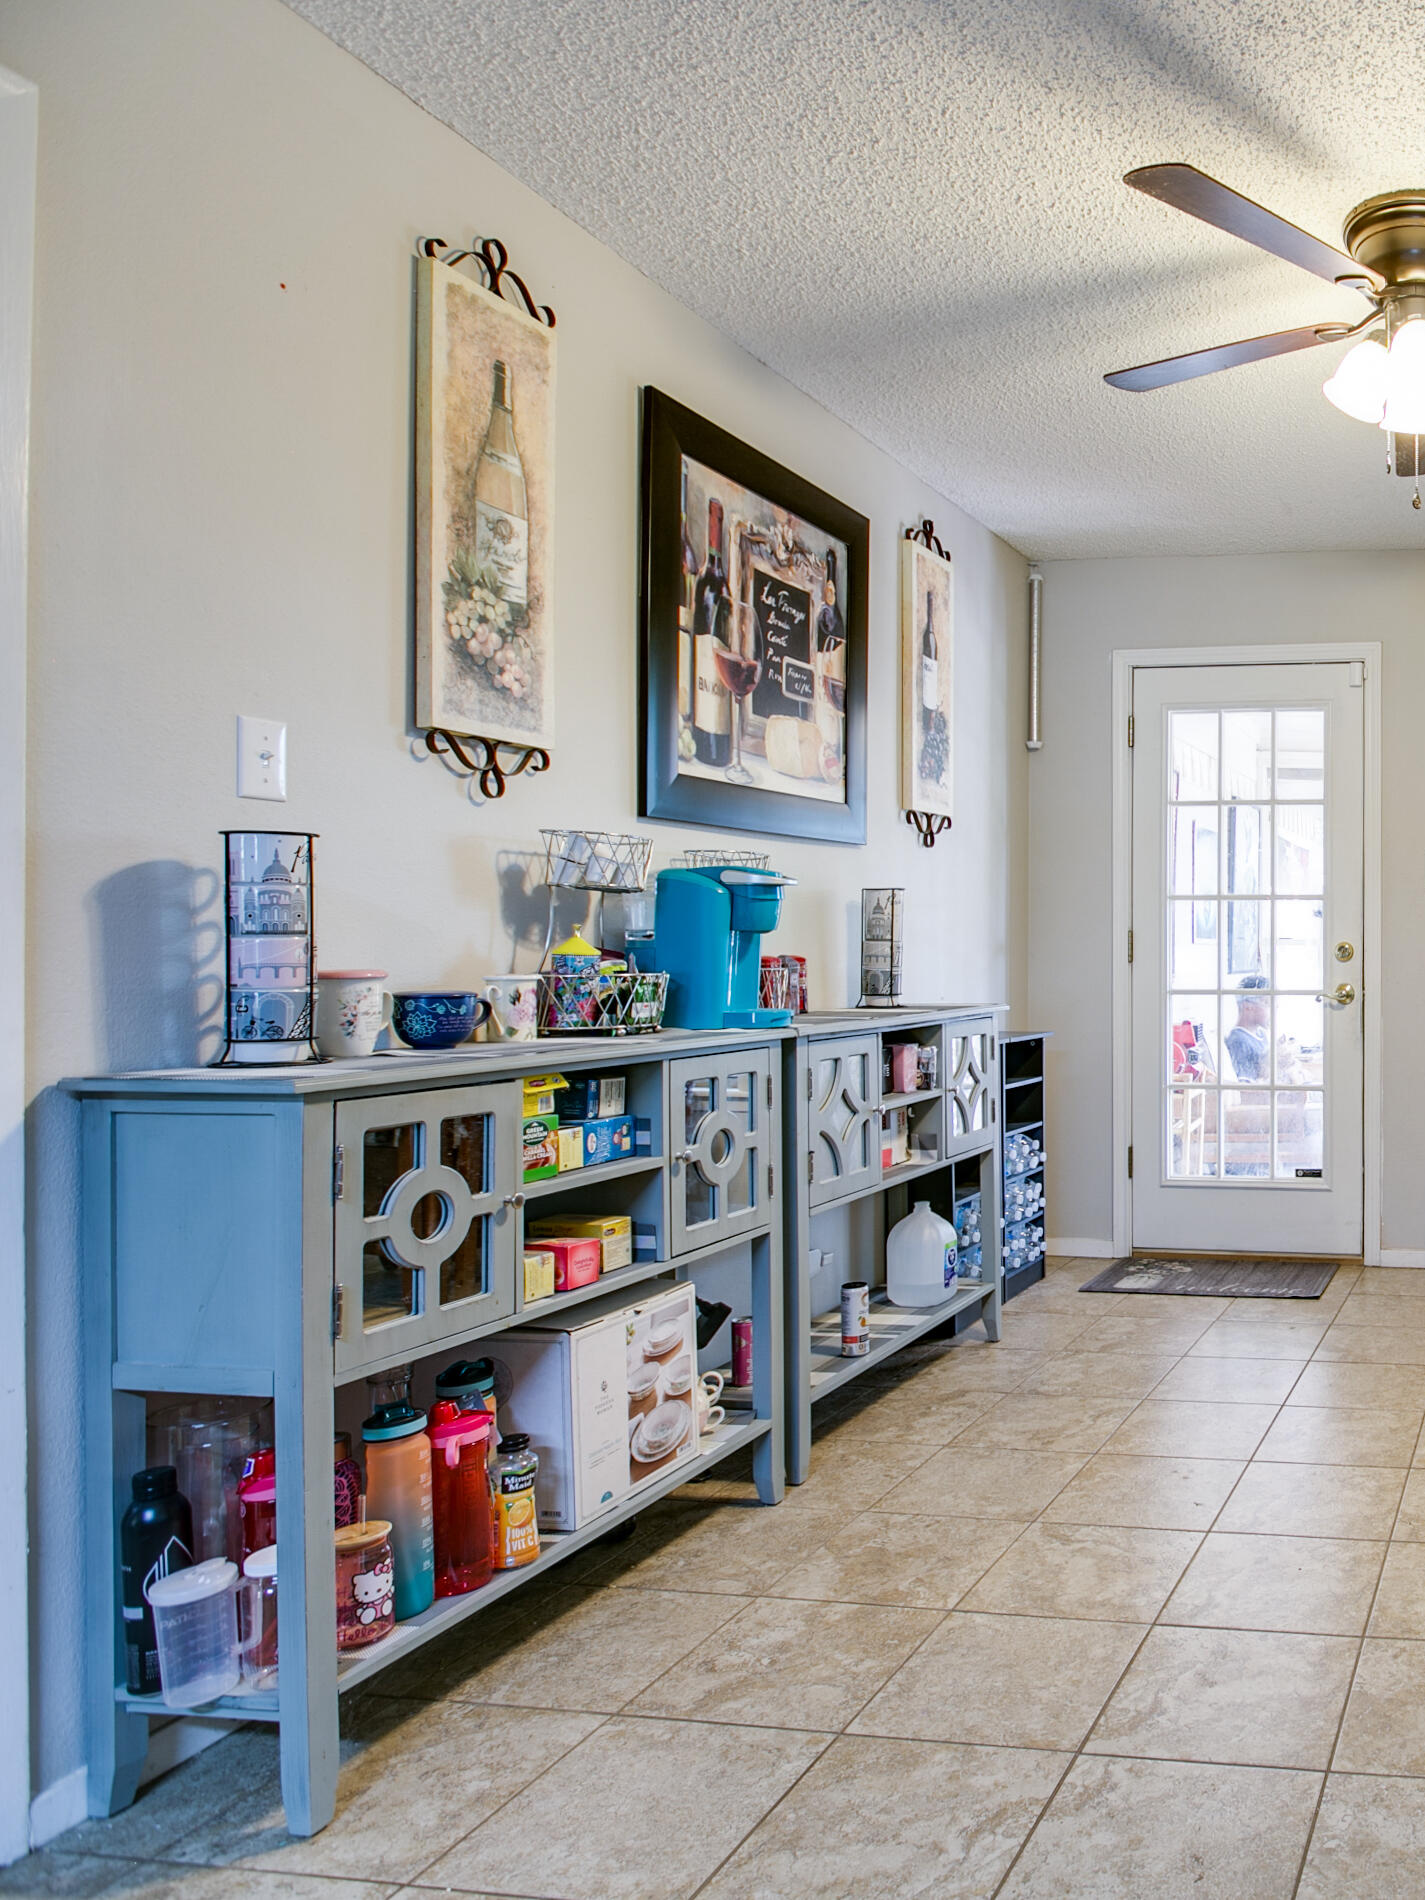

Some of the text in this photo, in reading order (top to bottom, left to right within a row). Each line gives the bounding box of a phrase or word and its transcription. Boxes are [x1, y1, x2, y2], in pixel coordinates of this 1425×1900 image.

[505, 1472, 536, 1485] Minute
[508, 1479, 533, 1492] Maid
[511, 1526, 534, 1539] 100%
[511, 1538, 526, 1551] VIT
